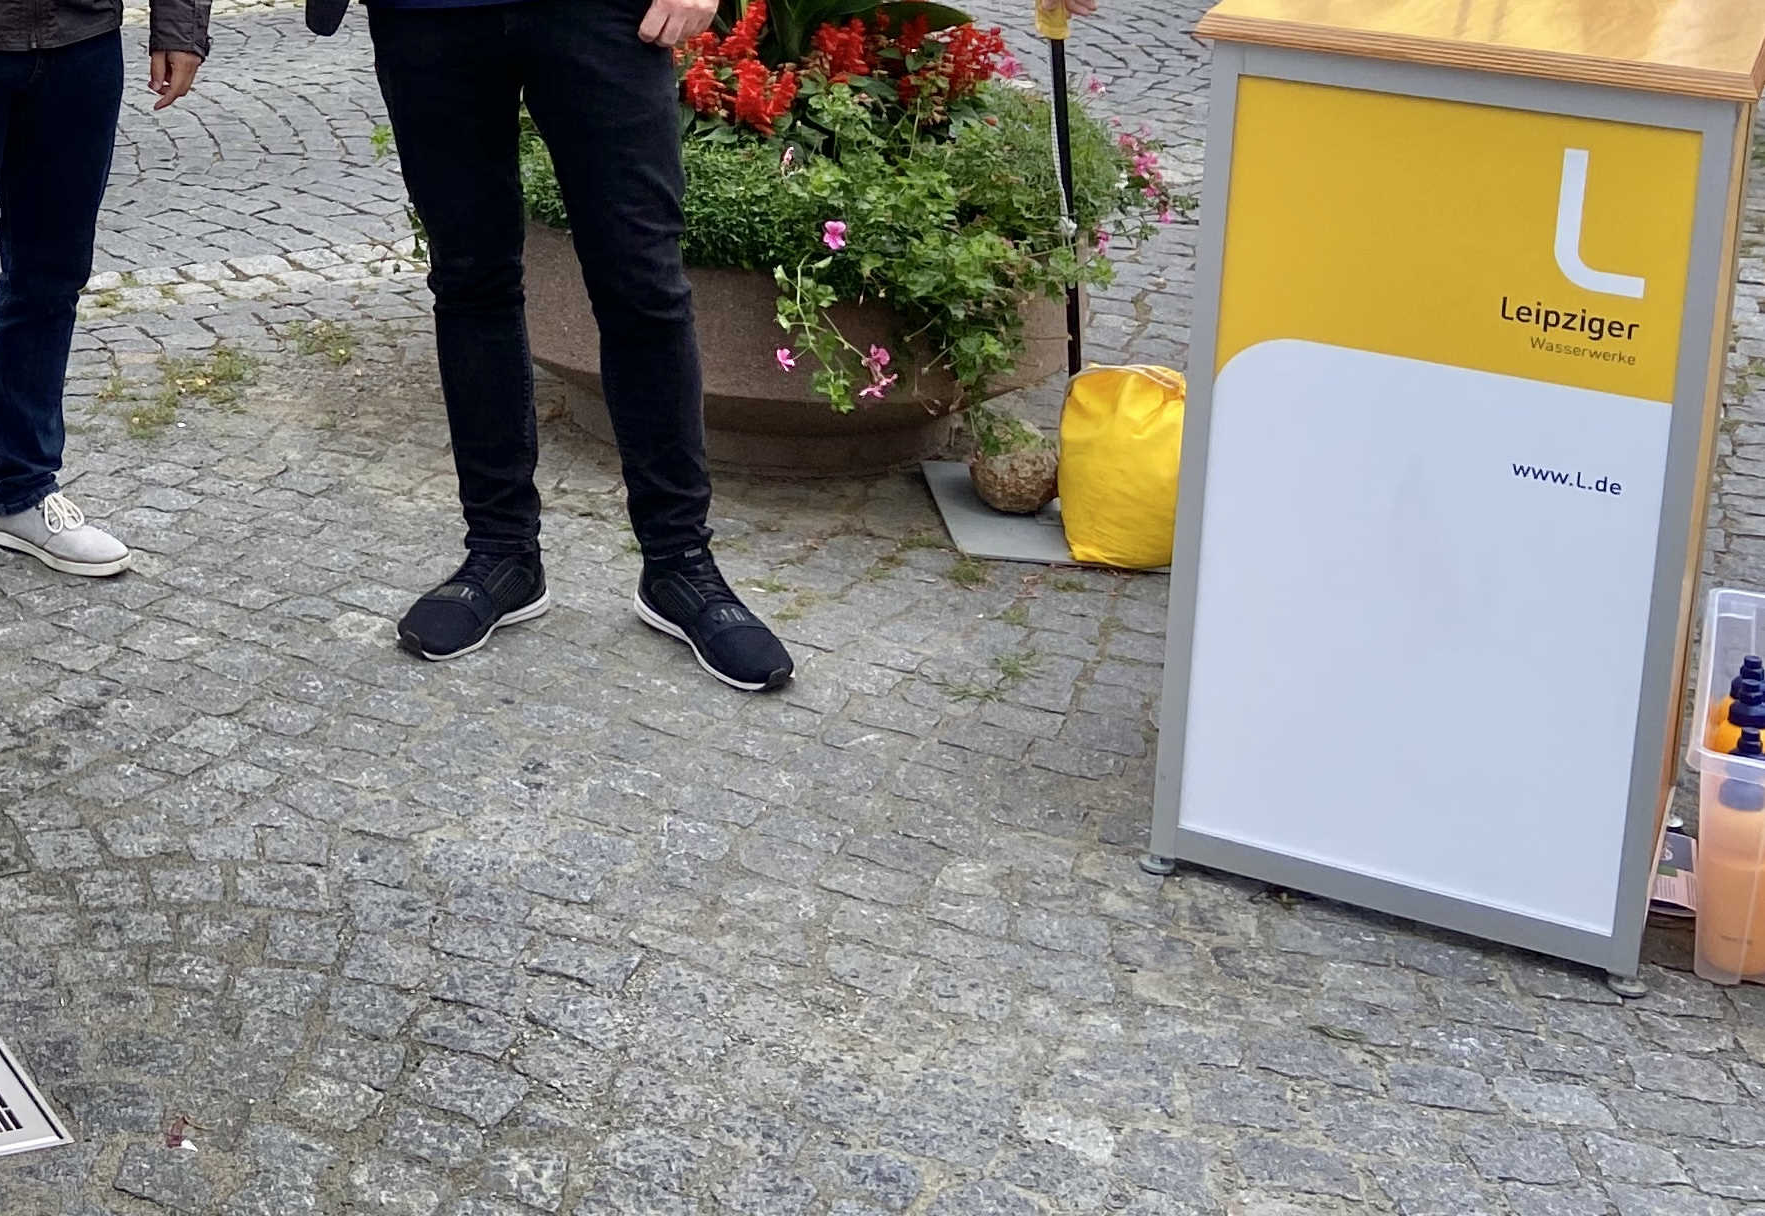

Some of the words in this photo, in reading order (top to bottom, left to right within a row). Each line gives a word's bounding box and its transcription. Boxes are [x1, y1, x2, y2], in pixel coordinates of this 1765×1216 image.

[1500, 295, 1640, 342] Leipziger
[1530, 335, 1637, 367] Wasserwerke
[1512, 462, 1623, 496] www.L.de
